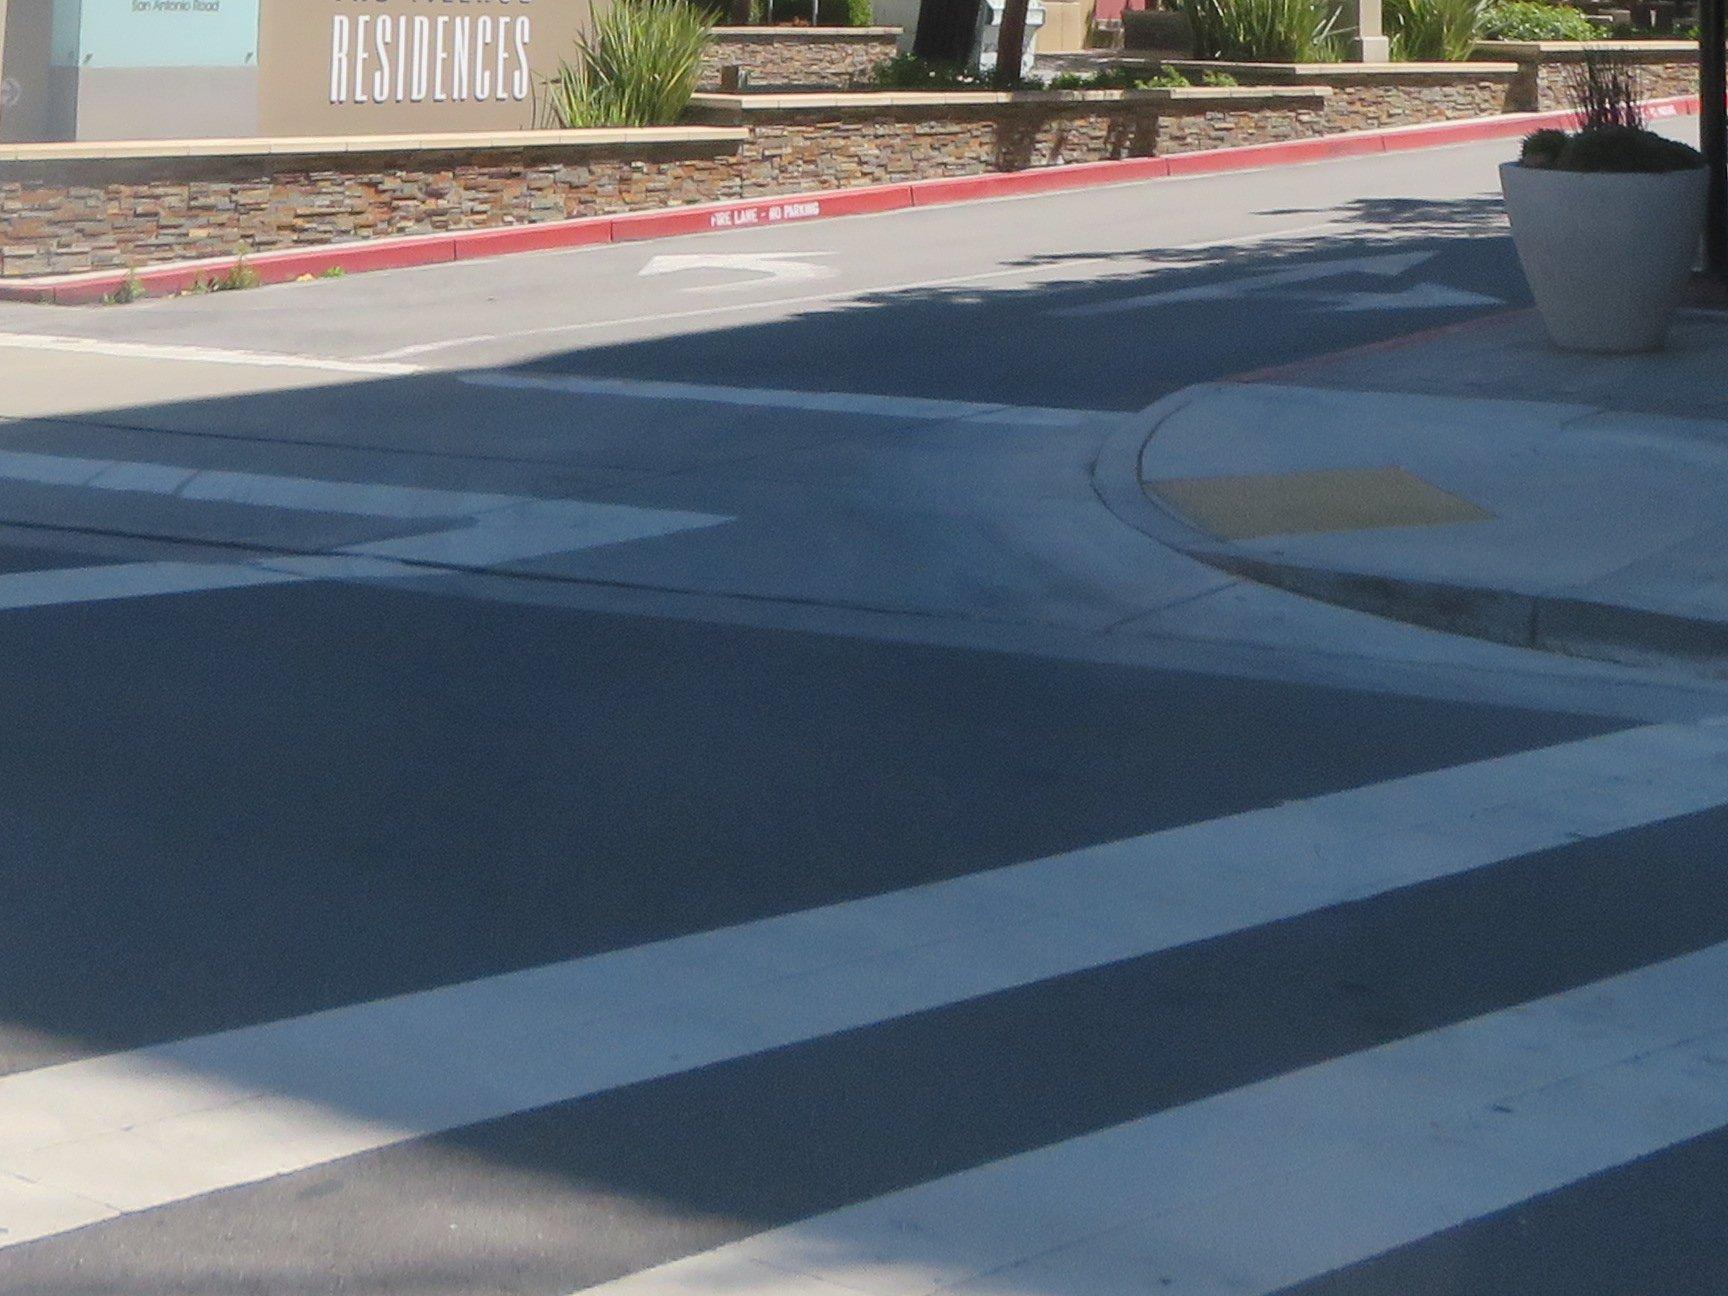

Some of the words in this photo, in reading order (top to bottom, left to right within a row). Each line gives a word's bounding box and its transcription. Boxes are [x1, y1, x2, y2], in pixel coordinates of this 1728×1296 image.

[330, 14, 531, 103] RESIDENCES
[711, 211, 732, 227] FIRE
[733, 208, 759, 225] LANE
[768, 206, 782, 221] NO
[783, 201, 820, 219] PARKING
